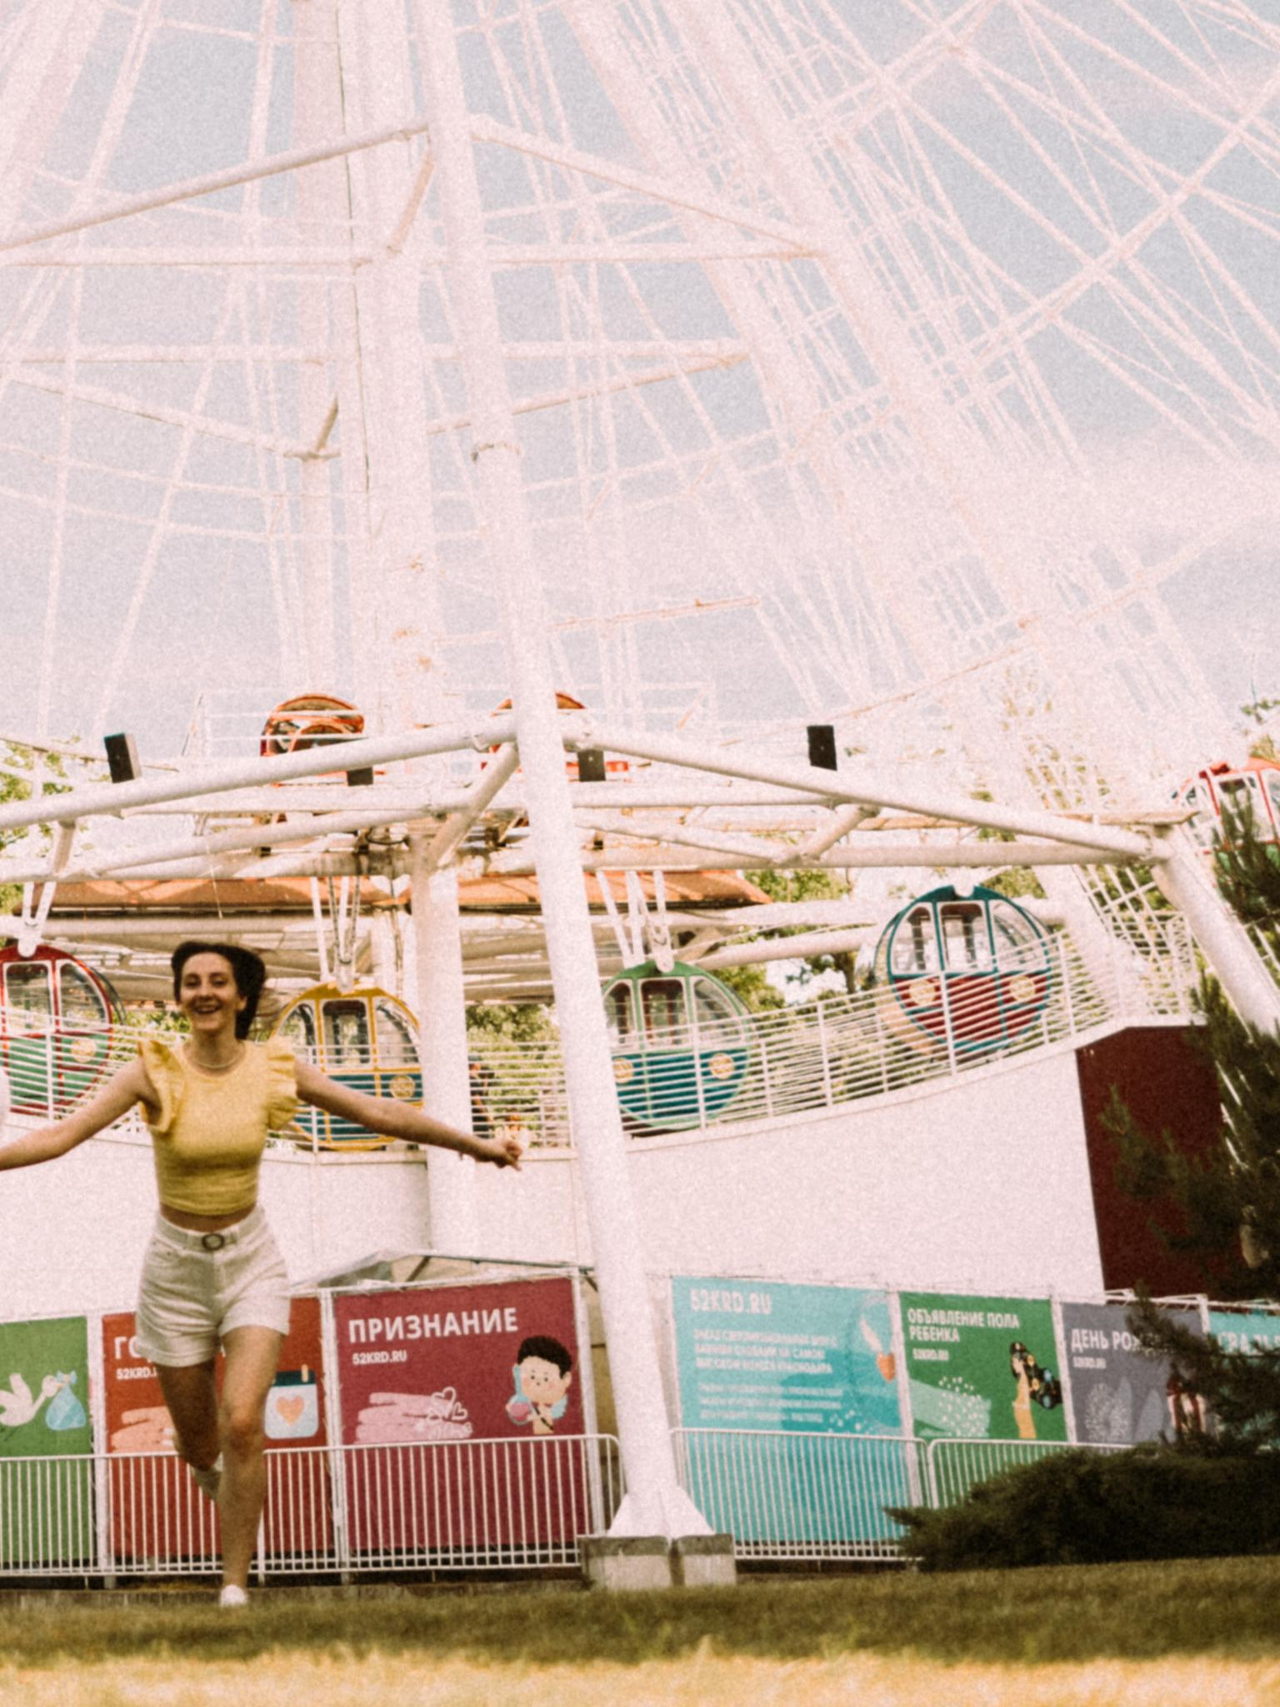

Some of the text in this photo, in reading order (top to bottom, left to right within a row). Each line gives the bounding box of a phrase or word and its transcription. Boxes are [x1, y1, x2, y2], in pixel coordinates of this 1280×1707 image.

[690, 1288, 772, 1314] 52KRD.RU
[349, 1307, 518, 1343] ПРИЗНАНИЕ
[907, 1308, 1020, 1328] ОБЪЯВЛЕНИЕ ПОЛА
[909, 1326, 960, 1342] РЕБЕНКА
[1071, 1329, 1109, 1353] ДЕНЬ
[352, 1350, 407, 1365] 52KRD.RU
